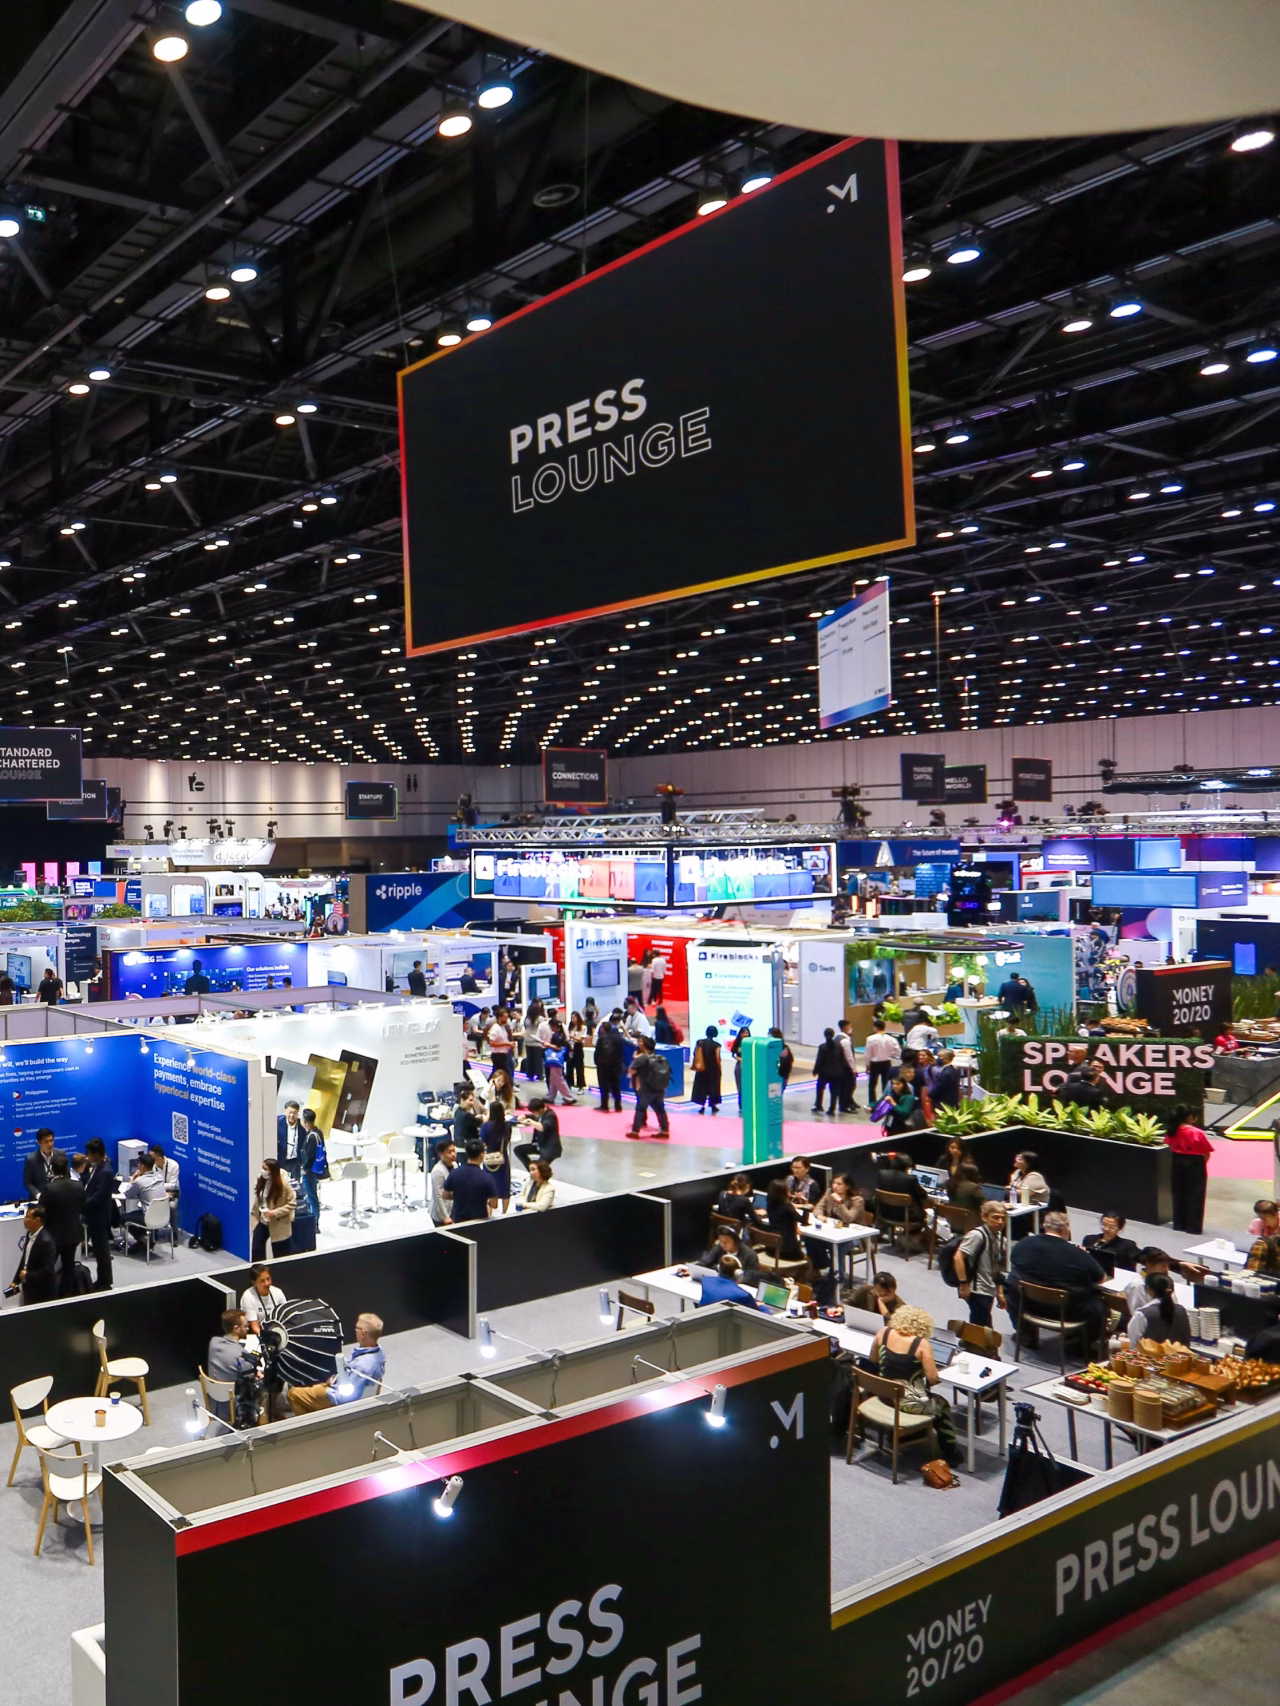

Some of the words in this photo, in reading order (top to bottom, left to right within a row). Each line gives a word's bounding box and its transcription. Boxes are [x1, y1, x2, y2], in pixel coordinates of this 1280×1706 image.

[510, 378, 648, 464] PRESS
[511, 406, 713, 513] LOUNGE
[552, 772, 599, 781] CONNECTIONS
[496, 859, 593, 879] Fireblocks
[388, 883, 422, 899] ripple
[585, 938, 622, 948] Fireblocks
[711, 952, 759, 960] Fireblocks
[1172, 984, 1215, 1006] MONEY
[1173, 1005, 1211, 1025] 20/20
[2, 1061, 15, 1069] will,
[15, 1059, 29, 1067] we'll
[30, 1058, 45, 1066] build
[56, 1056, 69, 1064] way
[153, 1052, 191, 1072] Experience
[192, 1065, 237, 1084] world-class
[154, 1068, 189, 1088] payments,
[190, 1079, 222, 1095] embrace
[1023, 1069, 1176, 1095] LONGE
[154, 1081, 189, 1100] hyperlocal
[190, 1093, 225, 1111] expertise
[197, 1129, 215, 1139] payment
[220, 1155, 231, 1165] local
[1055, 1503, 1180, 1617] PRESS
[906, 1594, 993, 1663] MONEY
[390, 1583, 624, 1706] PRESS
[906, 1634, 984, 1698] 20/20
